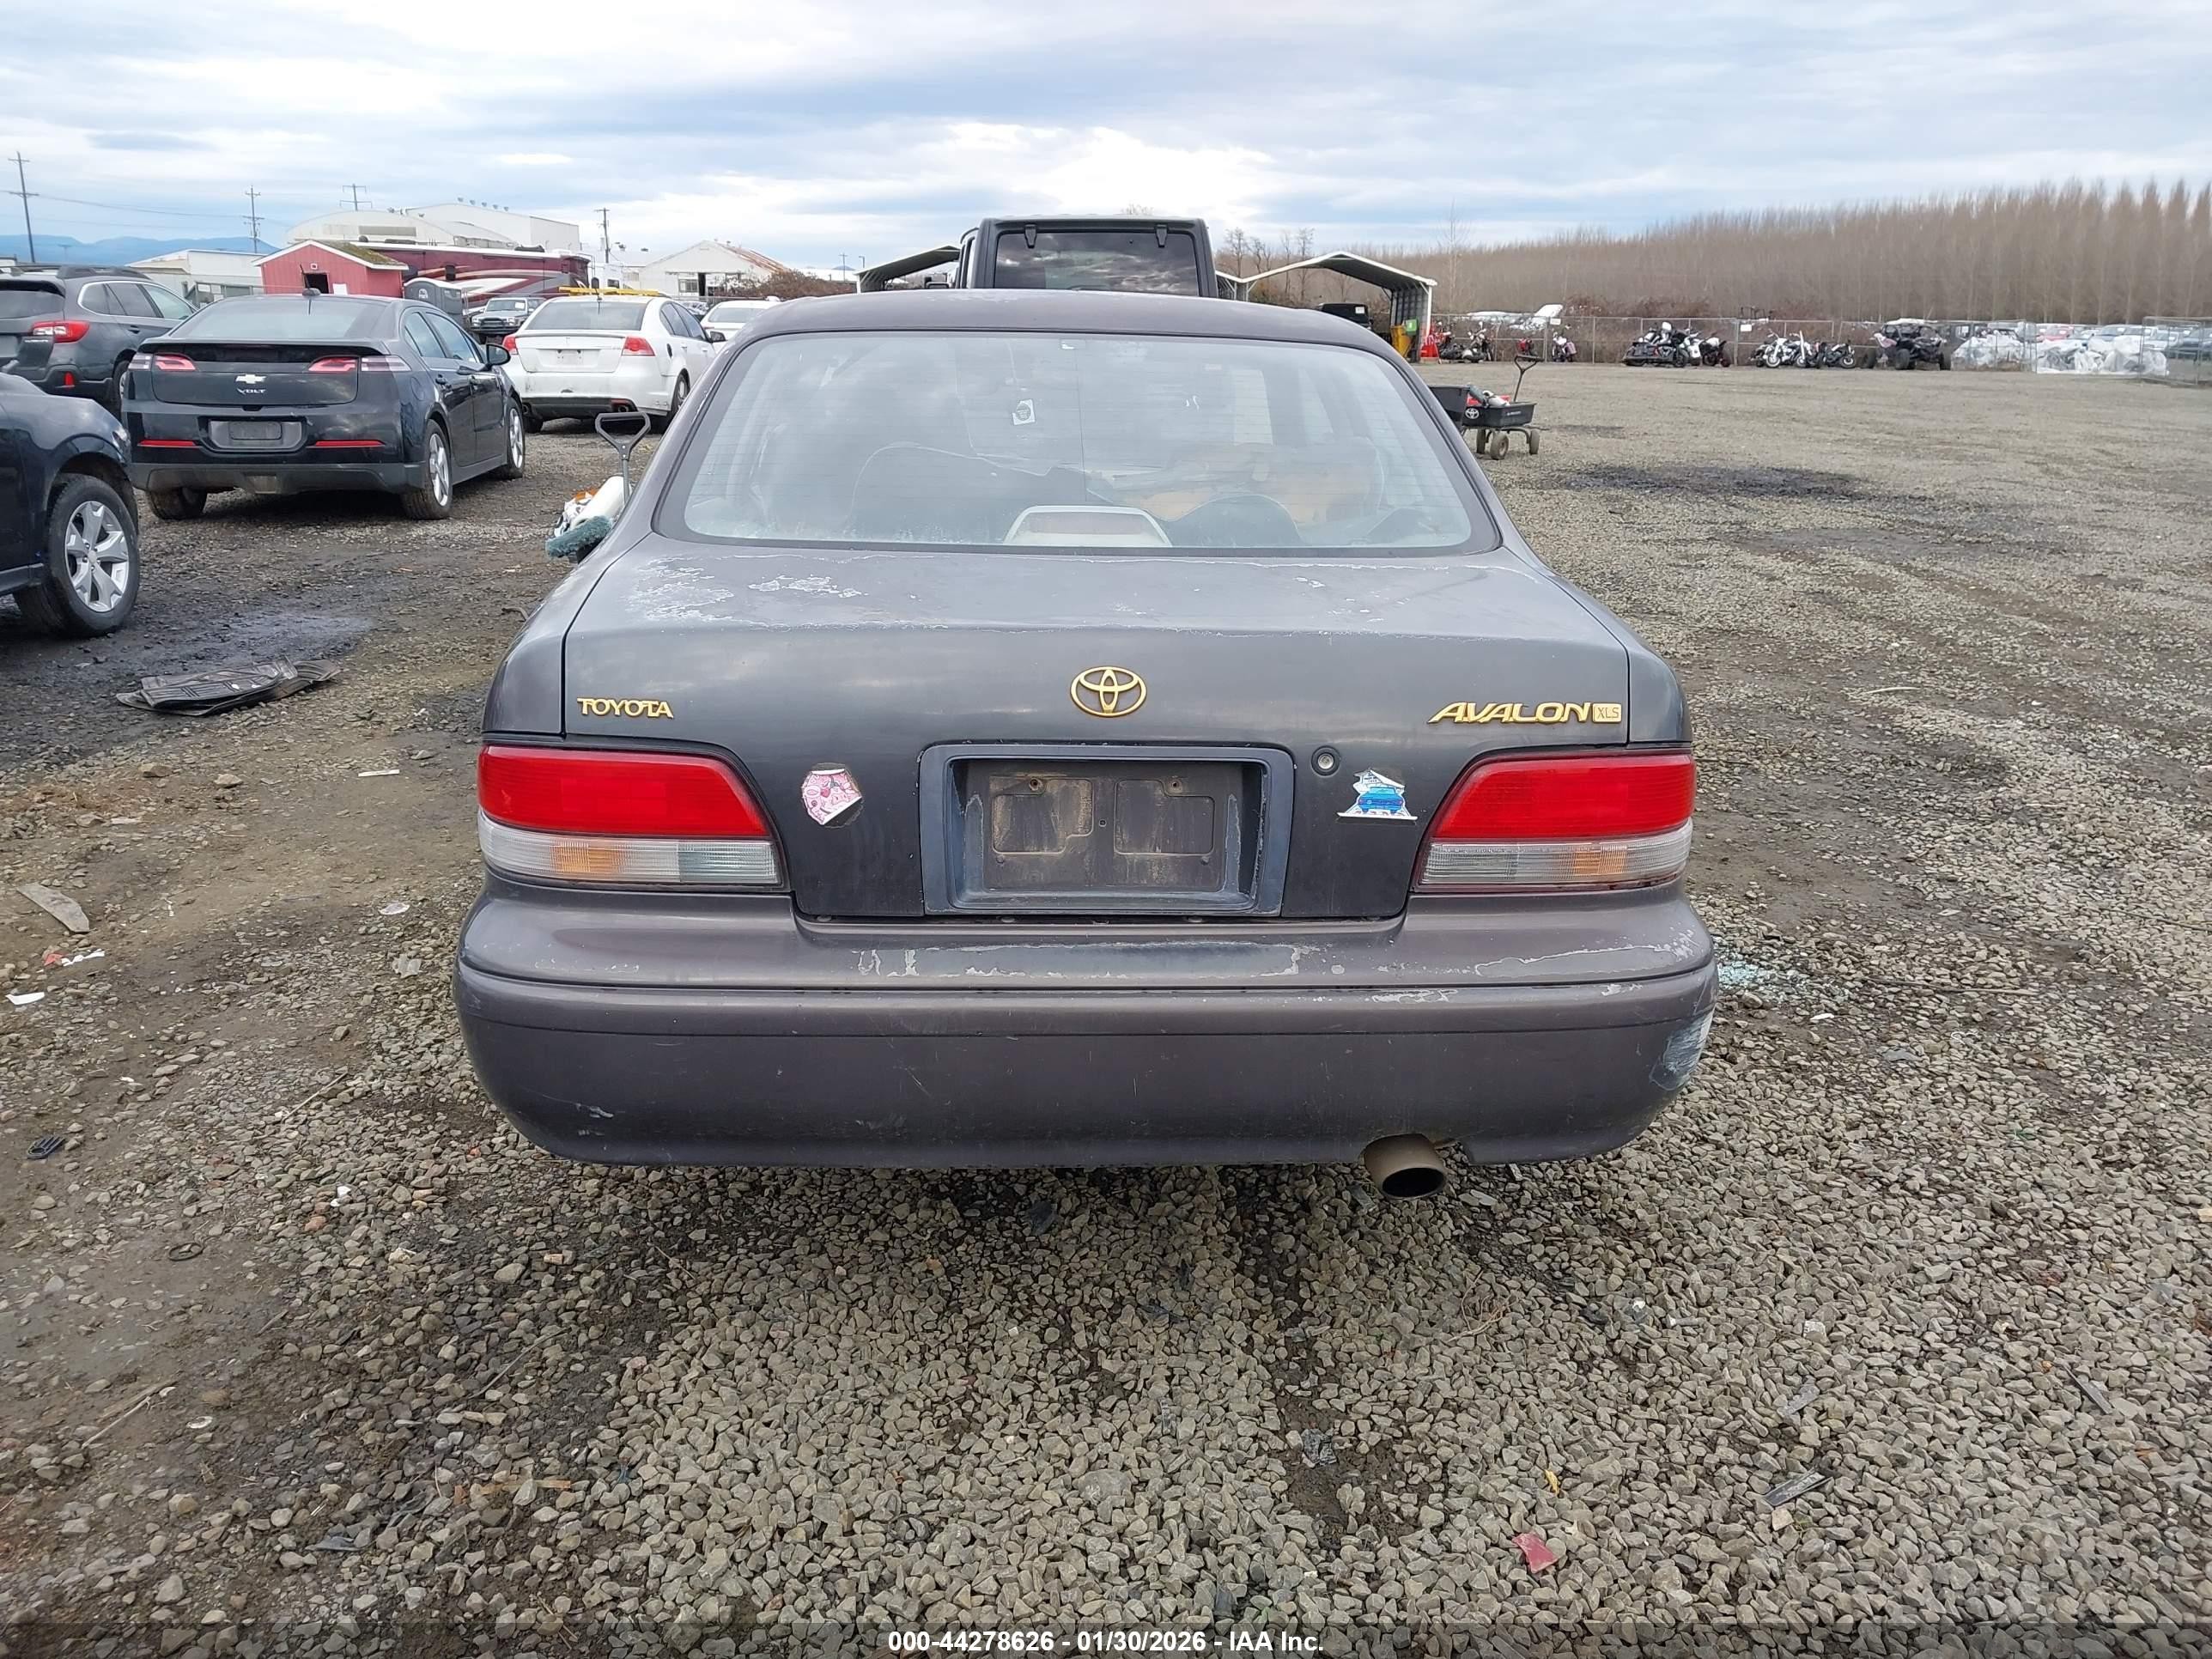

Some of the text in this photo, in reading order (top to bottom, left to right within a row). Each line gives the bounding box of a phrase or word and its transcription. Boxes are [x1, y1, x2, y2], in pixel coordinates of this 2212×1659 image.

[577, 697, 673, 719] TOYOTA
[1426, 702, 1620, 723] AVALON XLS
